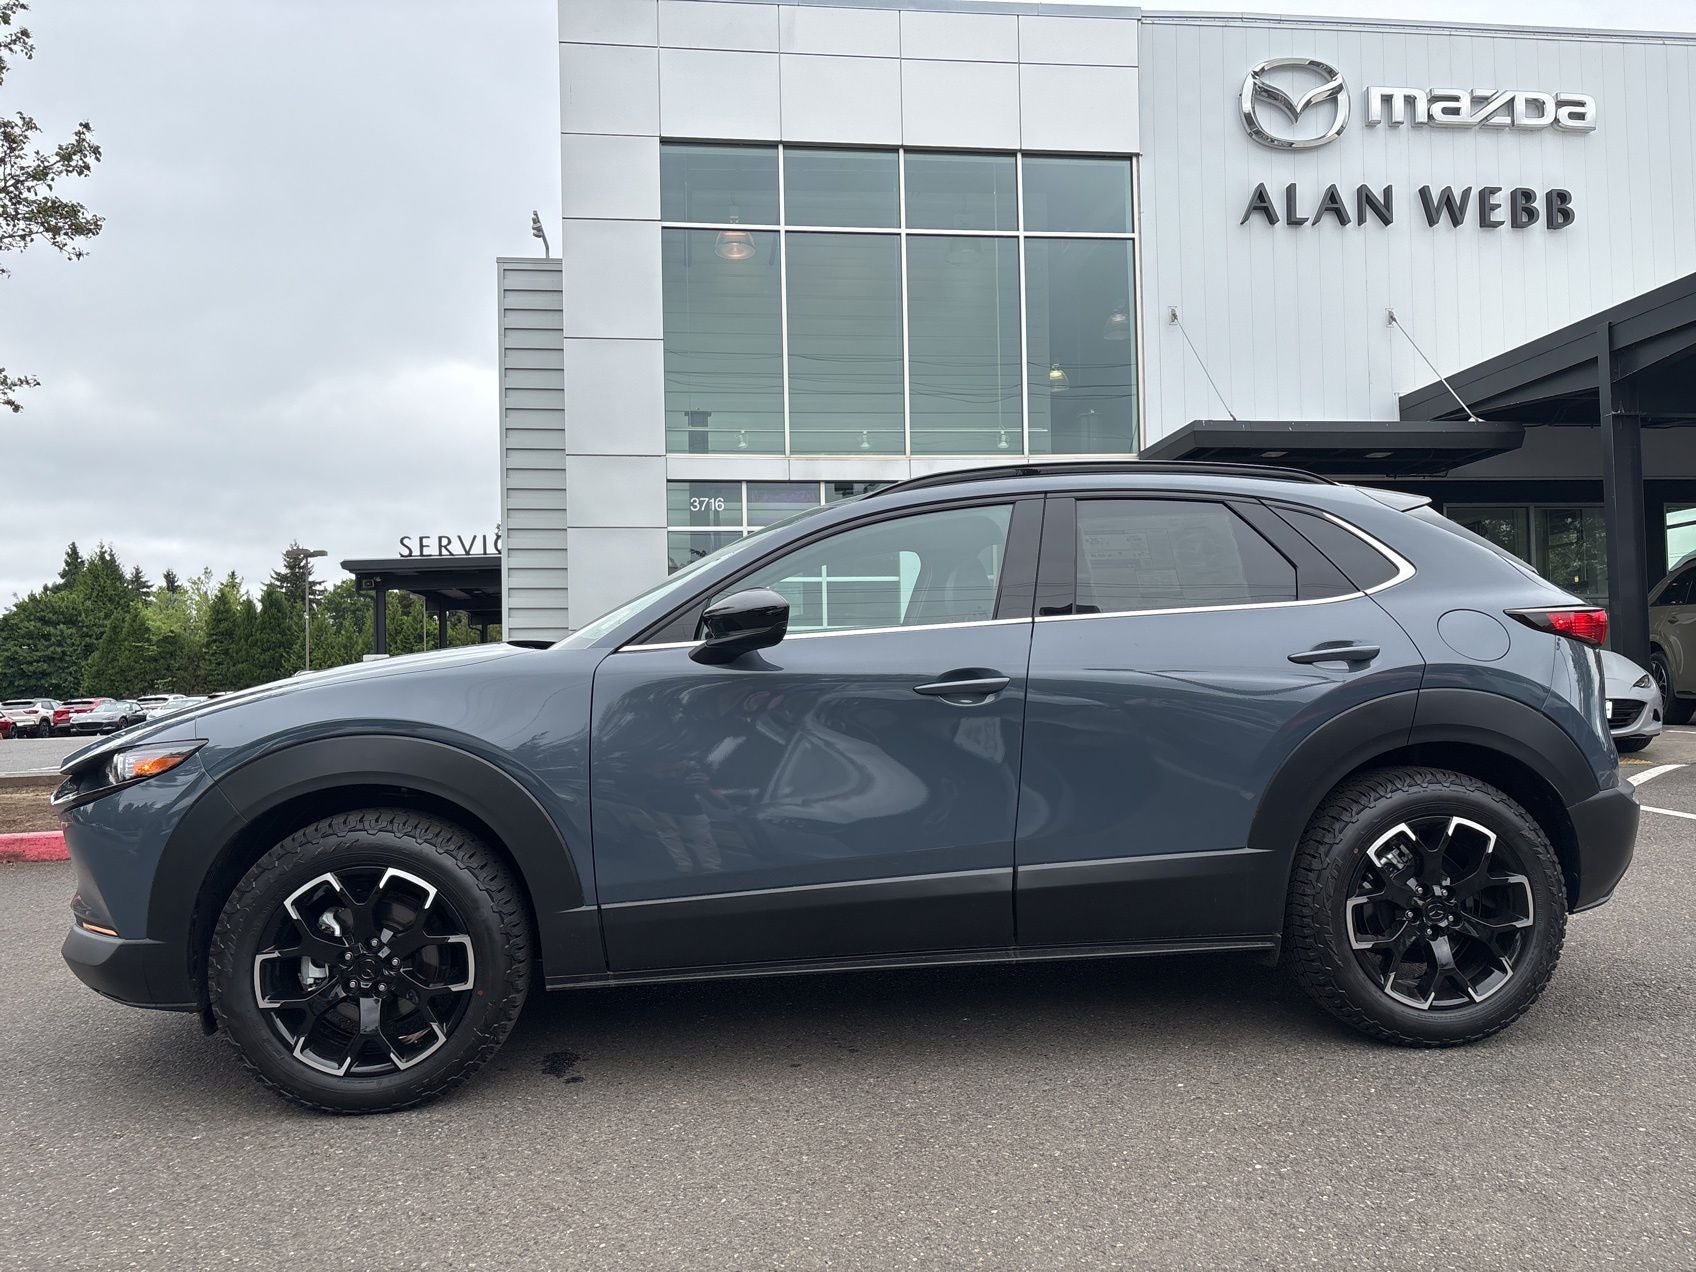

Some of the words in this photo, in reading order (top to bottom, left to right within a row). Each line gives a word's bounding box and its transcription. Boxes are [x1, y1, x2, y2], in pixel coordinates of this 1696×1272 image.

[1240, 182, 1394, 227] ALAN
[1417, 184, 1576, 230] WEBB
[690, 497, 724, 511] 3716
